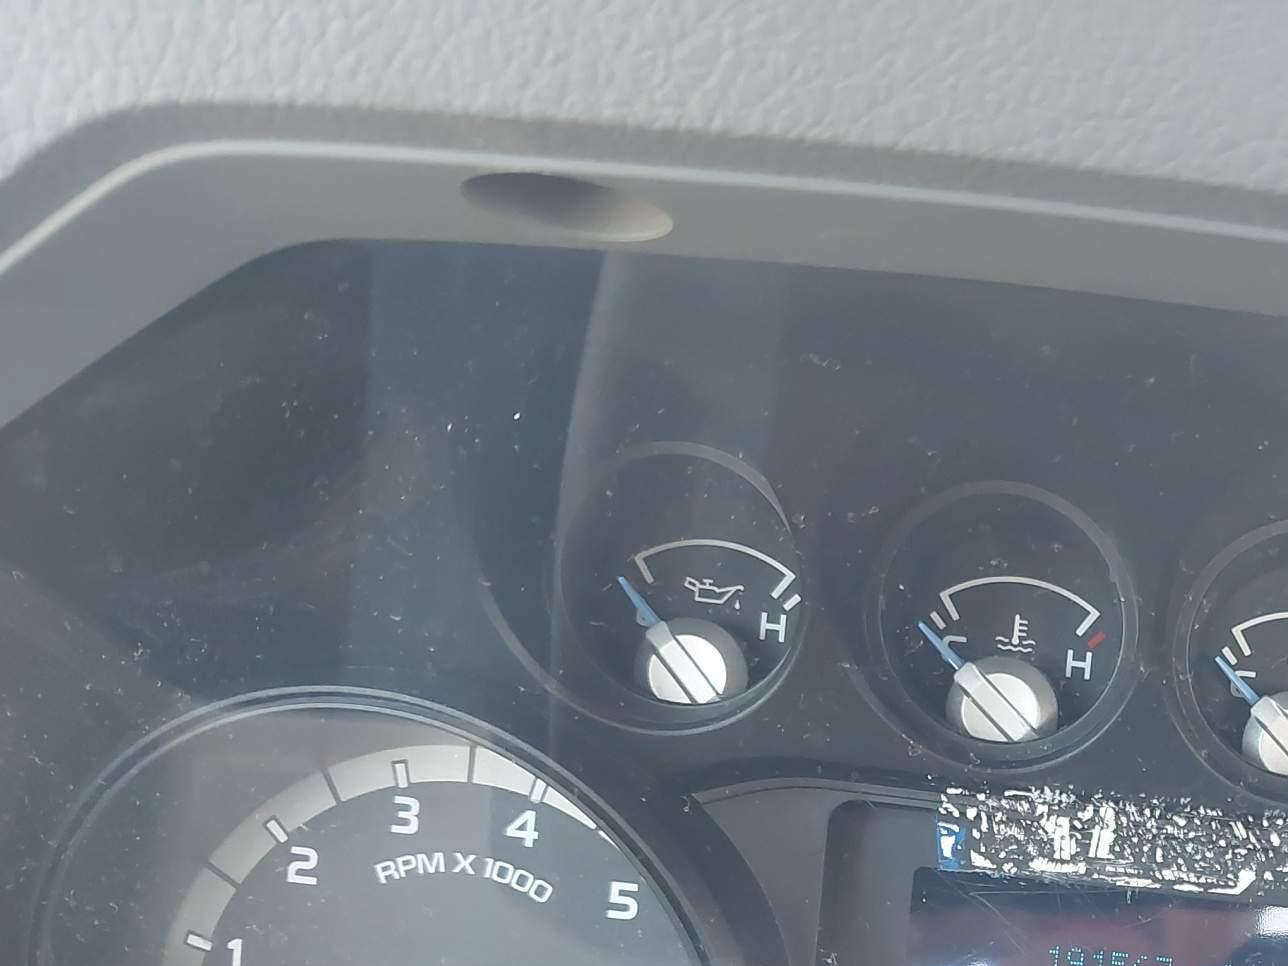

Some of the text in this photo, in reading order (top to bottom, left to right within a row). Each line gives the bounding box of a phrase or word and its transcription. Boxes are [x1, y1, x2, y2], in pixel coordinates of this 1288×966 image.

[760, 612, 787, 643] H
[1065, 649, 1093, 680] H
[391, 797, 420, 834] 3
[505, 811, 539, 847] 4
[287, 847, 319, 885] 2
[374, 852, 553, 903] RPM X 1000
[607, 882, 639, 920] 5
